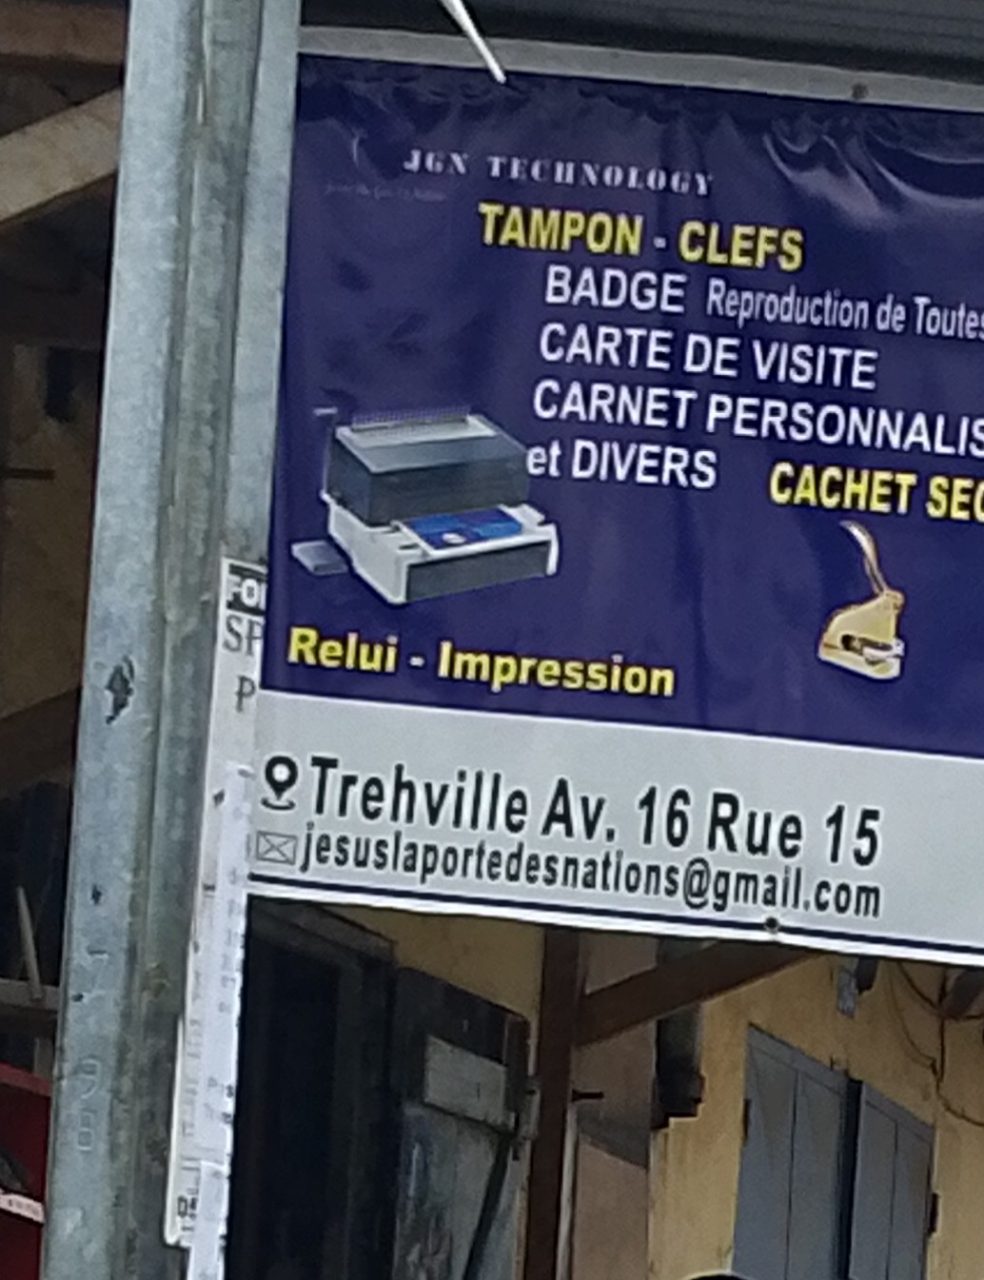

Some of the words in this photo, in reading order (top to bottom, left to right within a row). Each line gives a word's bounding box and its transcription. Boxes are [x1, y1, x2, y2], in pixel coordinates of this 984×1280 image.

[487, 154, 714, 197] TECHNOLOGY
[478, 202, 643, 256] TAMPON
[678, 222, 805, 271] CLEFS
[546, 265, 688, 313] BADGE
[706, 278, 869, 331] Reproduction
[876, 293, 906, 333] de
[539, 323, 674, 371] CARTE
[684, 334, 739, 378] DE
[753, 339, 879, 390] VISITE
[533, 379, 697, 430] CARNET
[526, 444, 562, 477] et
[572, 440, 718, 490] DIVERS
[769, 462, 917, 514] CACHET
[287, 627, 397, 672] Relui
[438, 641, 675, 697] Impression
[310, 756, 527, 834] Trehville
[542, 778, 615, 843] Av.
[638, 787, 690, 848] 16
[708, 792, 802, 859] Rue
[825, 805, 881, 867] 15
[300, 823, 882, 918] jesuslaportedesnations@gmail.com
